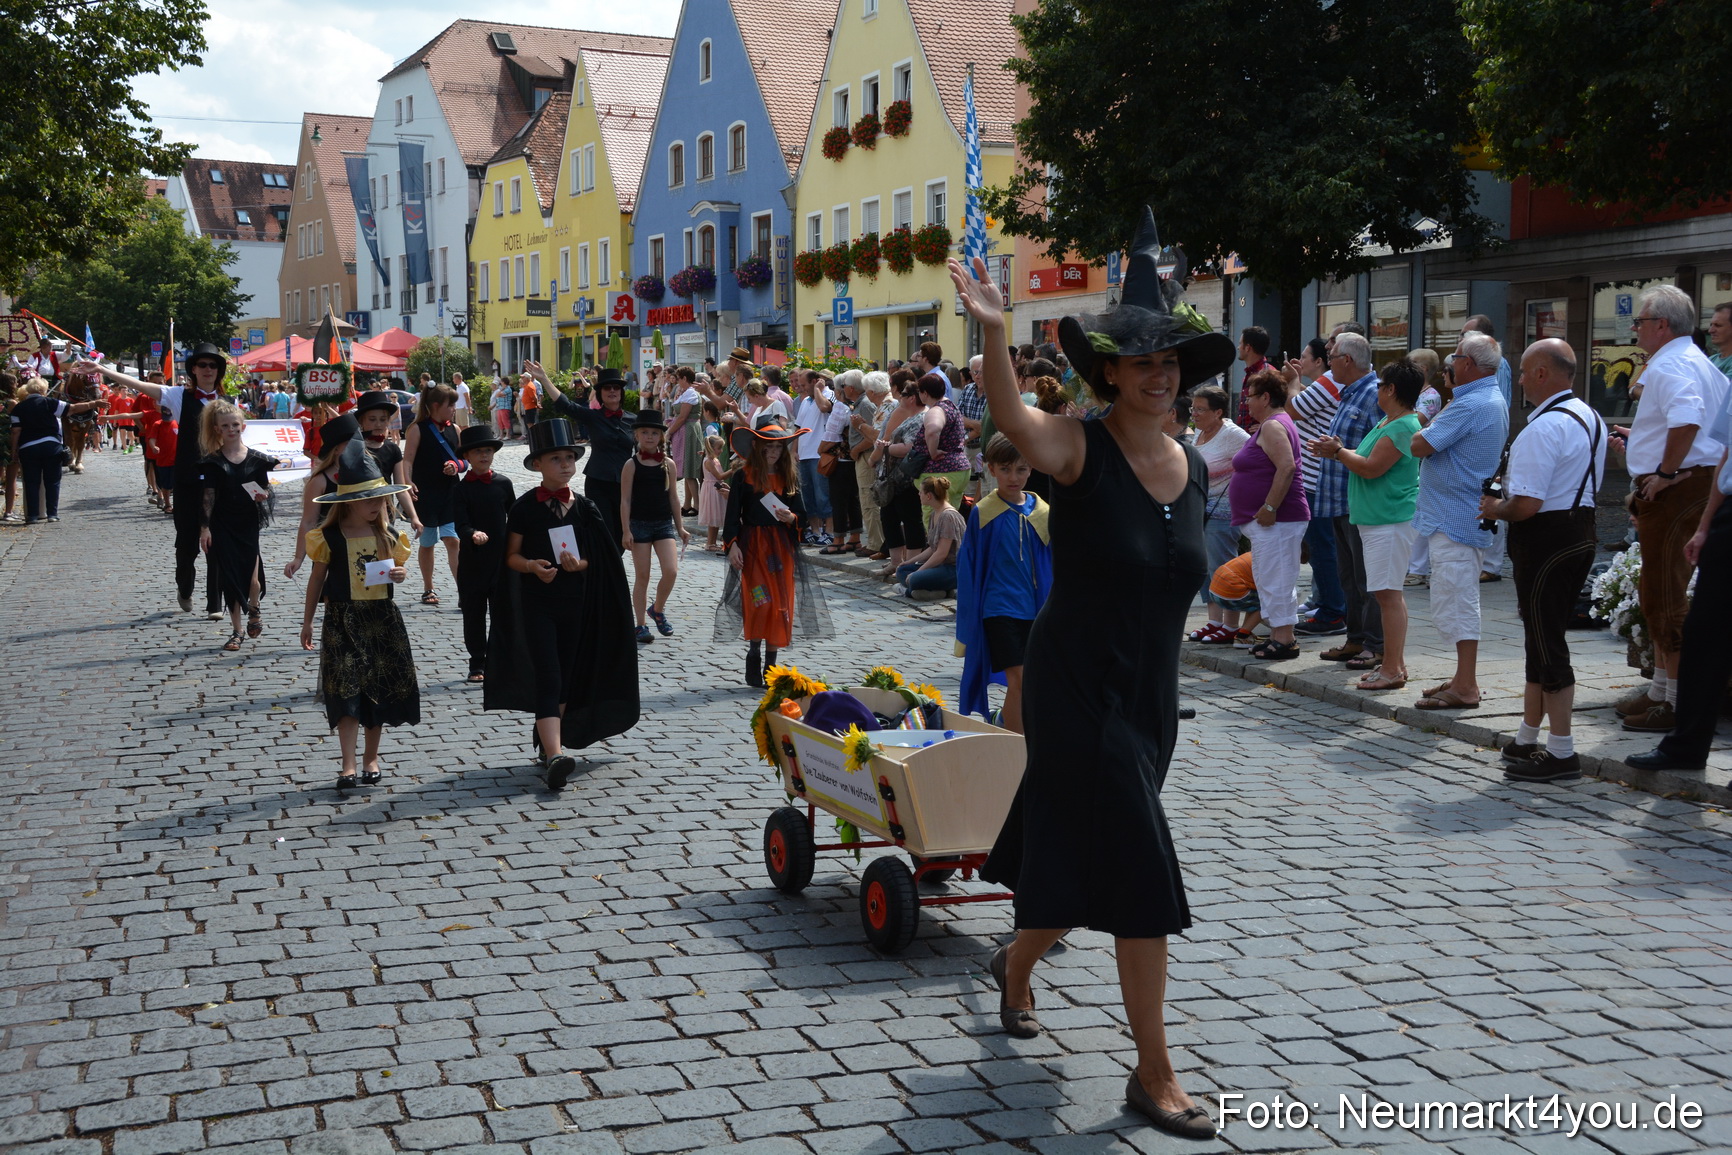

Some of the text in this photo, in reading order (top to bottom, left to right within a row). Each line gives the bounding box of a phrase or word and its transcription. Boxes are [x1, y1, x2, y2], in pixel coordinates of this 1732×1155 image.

[404, 192, 424, 234] K&L
[503, 233, 523, 251] HOTEL
[1064, 270, 1082, 280] DER
[1110, 252, 1117, 279] P
[777, 250, 787, 303] WITTL
[1030, 278, 1041, 289] DER
[572, 303, 590, 313] TAIN
[646, 304, 695, 326] APOTHEKE
[837, 301, 849, 323] P
[503, 317, 529, 330] Restaurant
[309, 370, 338, 383] BSC
[802, 763, 878, 806] Die Zauberer von Wolfstein
